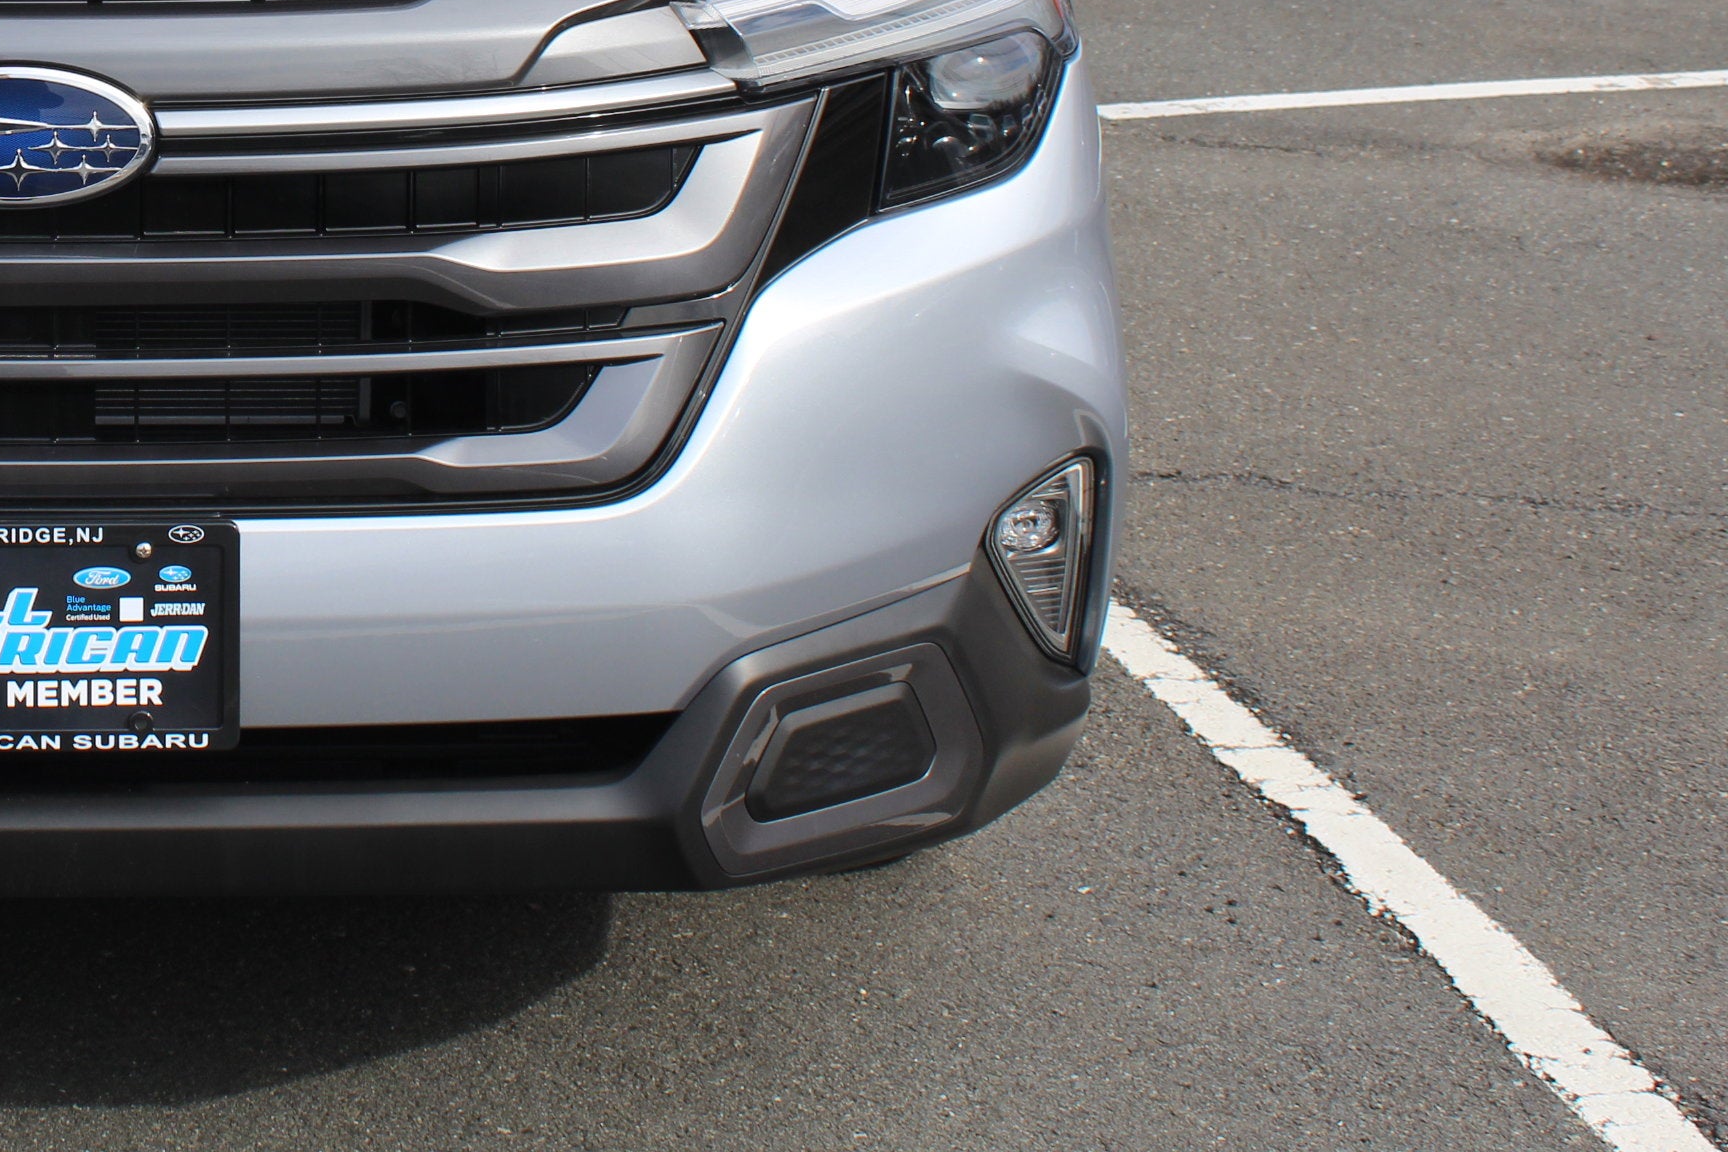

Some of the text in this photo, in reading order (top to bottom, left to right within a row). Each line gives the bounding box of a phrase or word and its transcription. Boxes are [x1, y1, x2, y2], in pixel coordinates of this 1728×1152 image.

[84, 570, 120, 586] Ford
[154, 583, 197, 592] SUBARU
[66, 595, 86, 604] Blue
[66, 603, 112, 613] Advantage
[65, 613, 111, 622] Certified Used
[6, 678, 163, 707] MEMBER
[72, 732, 209, 749] SUBARU
